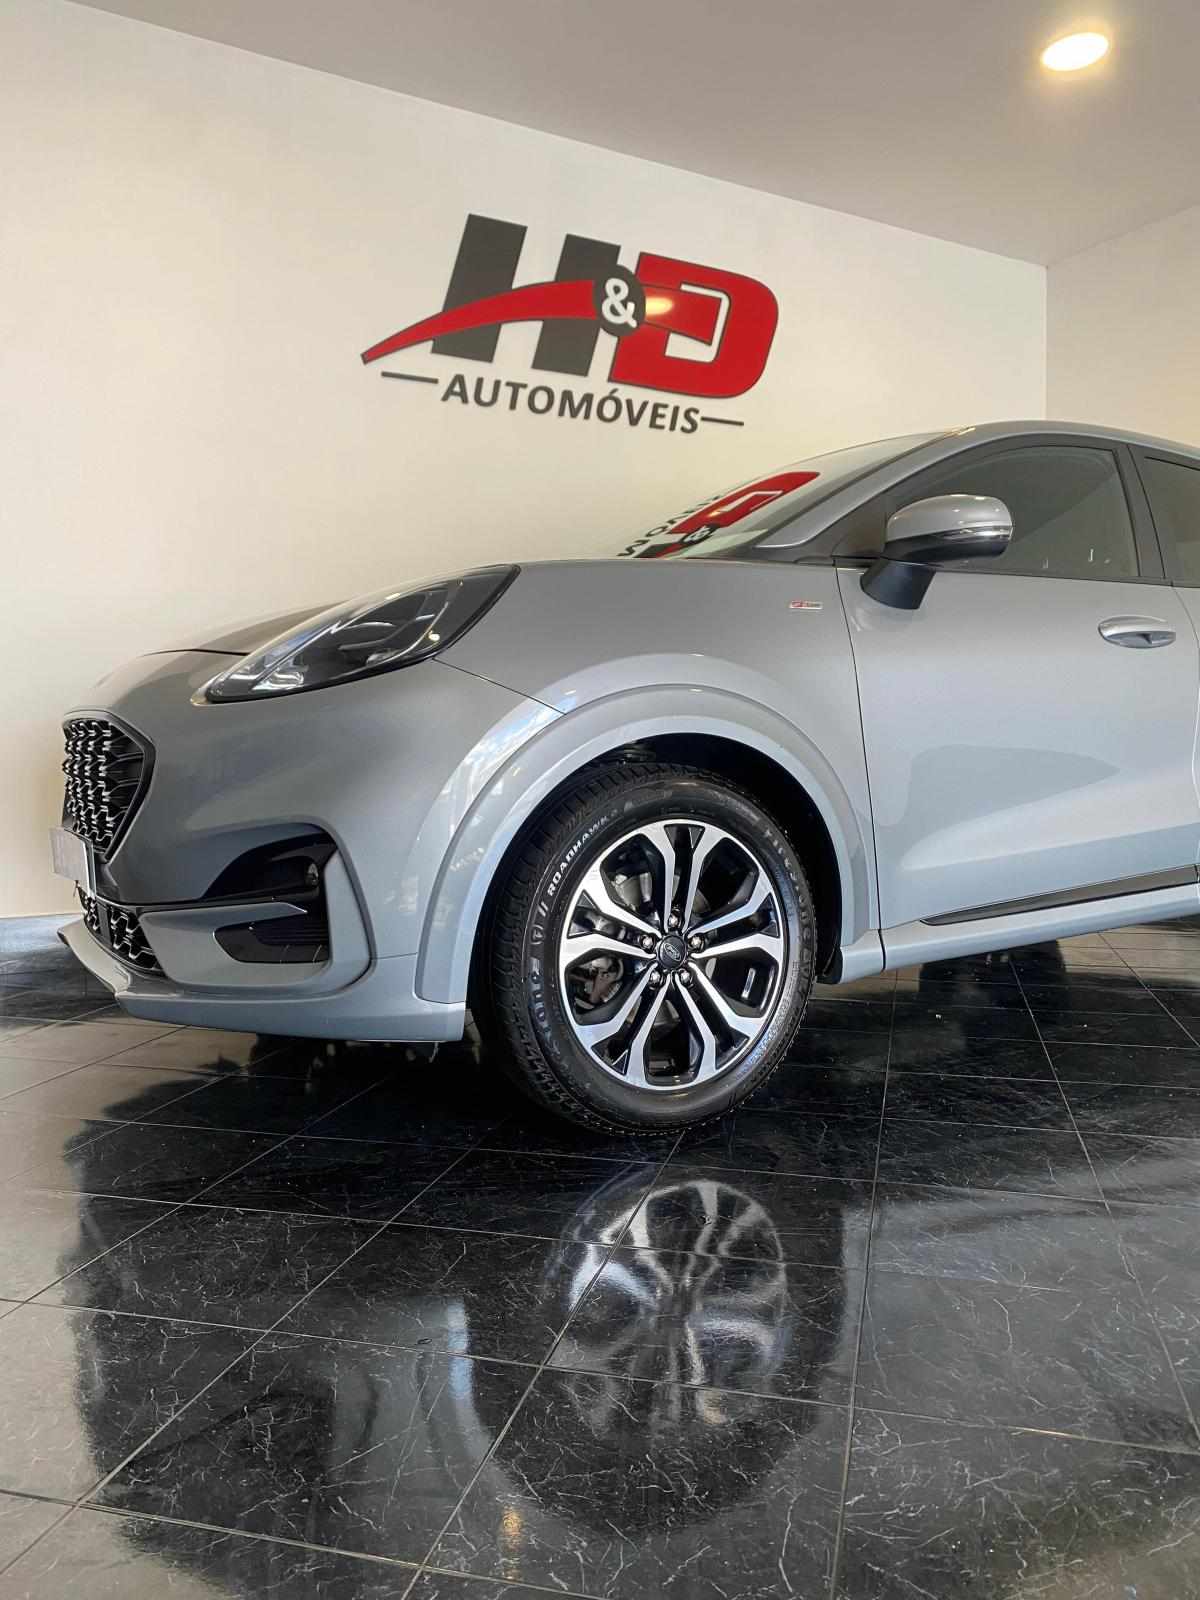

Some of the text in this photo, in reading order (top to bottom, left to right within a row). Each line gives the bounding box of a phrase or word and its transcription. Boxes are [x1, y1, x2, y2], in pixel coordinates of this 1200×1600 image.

[430, 213, 779, 398] H&D
[441, 374, 700, 434] AUTOMÓVEIS
[546, 815, 609, 897] ROADHAWK
